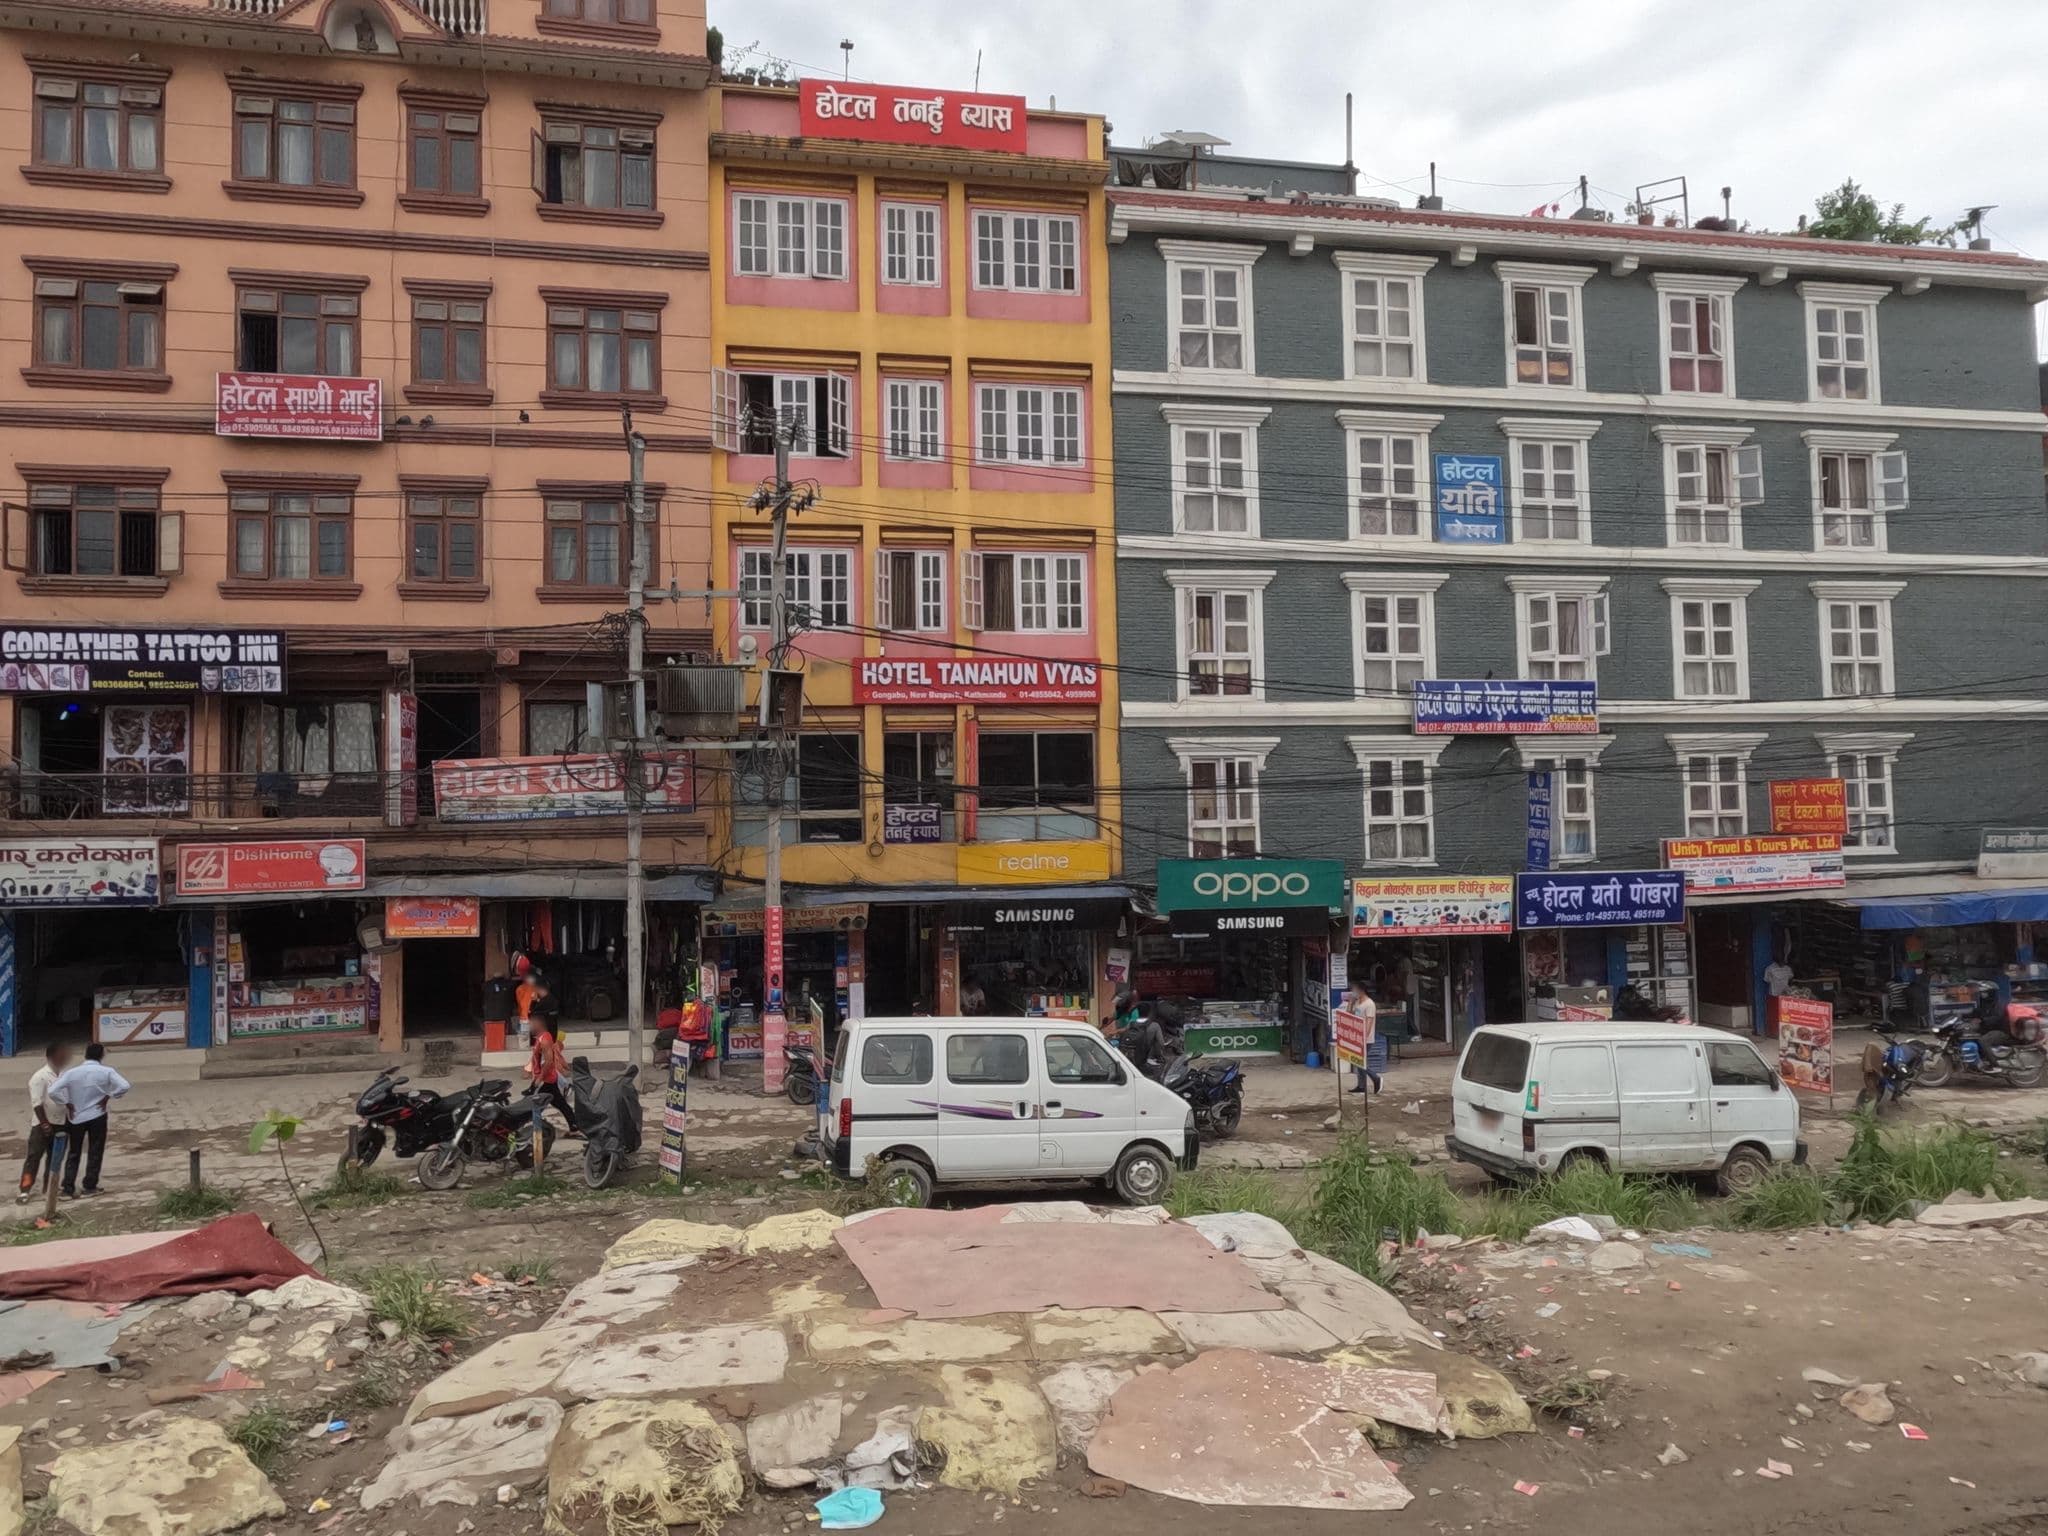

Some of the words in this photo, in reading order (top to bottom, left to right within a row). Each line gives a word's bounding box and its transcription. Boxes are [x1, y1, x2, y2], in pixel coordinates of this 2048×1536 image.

[816, 85, 877, 120] होटल
[221, 376, 278, 414] होटल
[1441, 457, 1495, 481] होटल
[2, 630, 139, 661] GODFATHER
[145, 634, 232, 662] TATTOO
[863, 662, 932, 685] HOTEL
[938, 663, 1038, 685] TANAHUN
[1044, 663, 1097, 685] VYAS
[1529, 787, 1551, 801] HOTEL
[886, 807, 938, 826] होटल
[1529, 804, 1551, 818] YETI
[234, 848, 313, 861] DishHome
[1672, 842, 1702, 858] Unity
[1706, 840, 1740, 854] Travel
[1744, 840, 1752, 853] &
[1755, 838, 1787, 852] Tours
[1791, 837, 1812, 850] Pvt.
[1817, 836, 1838, 849] Ltd.
[998, 853, 1069, 871] realme
[1542, 880, 1585, 912] होटल
[1591, 877, 1622, 907] यती
[1629, 878, 1680, 908] पोखरा
[995, 908, 1075, 923] SAMSUNG
[1217, 916, 1284, 930] SAMSUNG
[1556, 912, 1584, 922] Phone:
